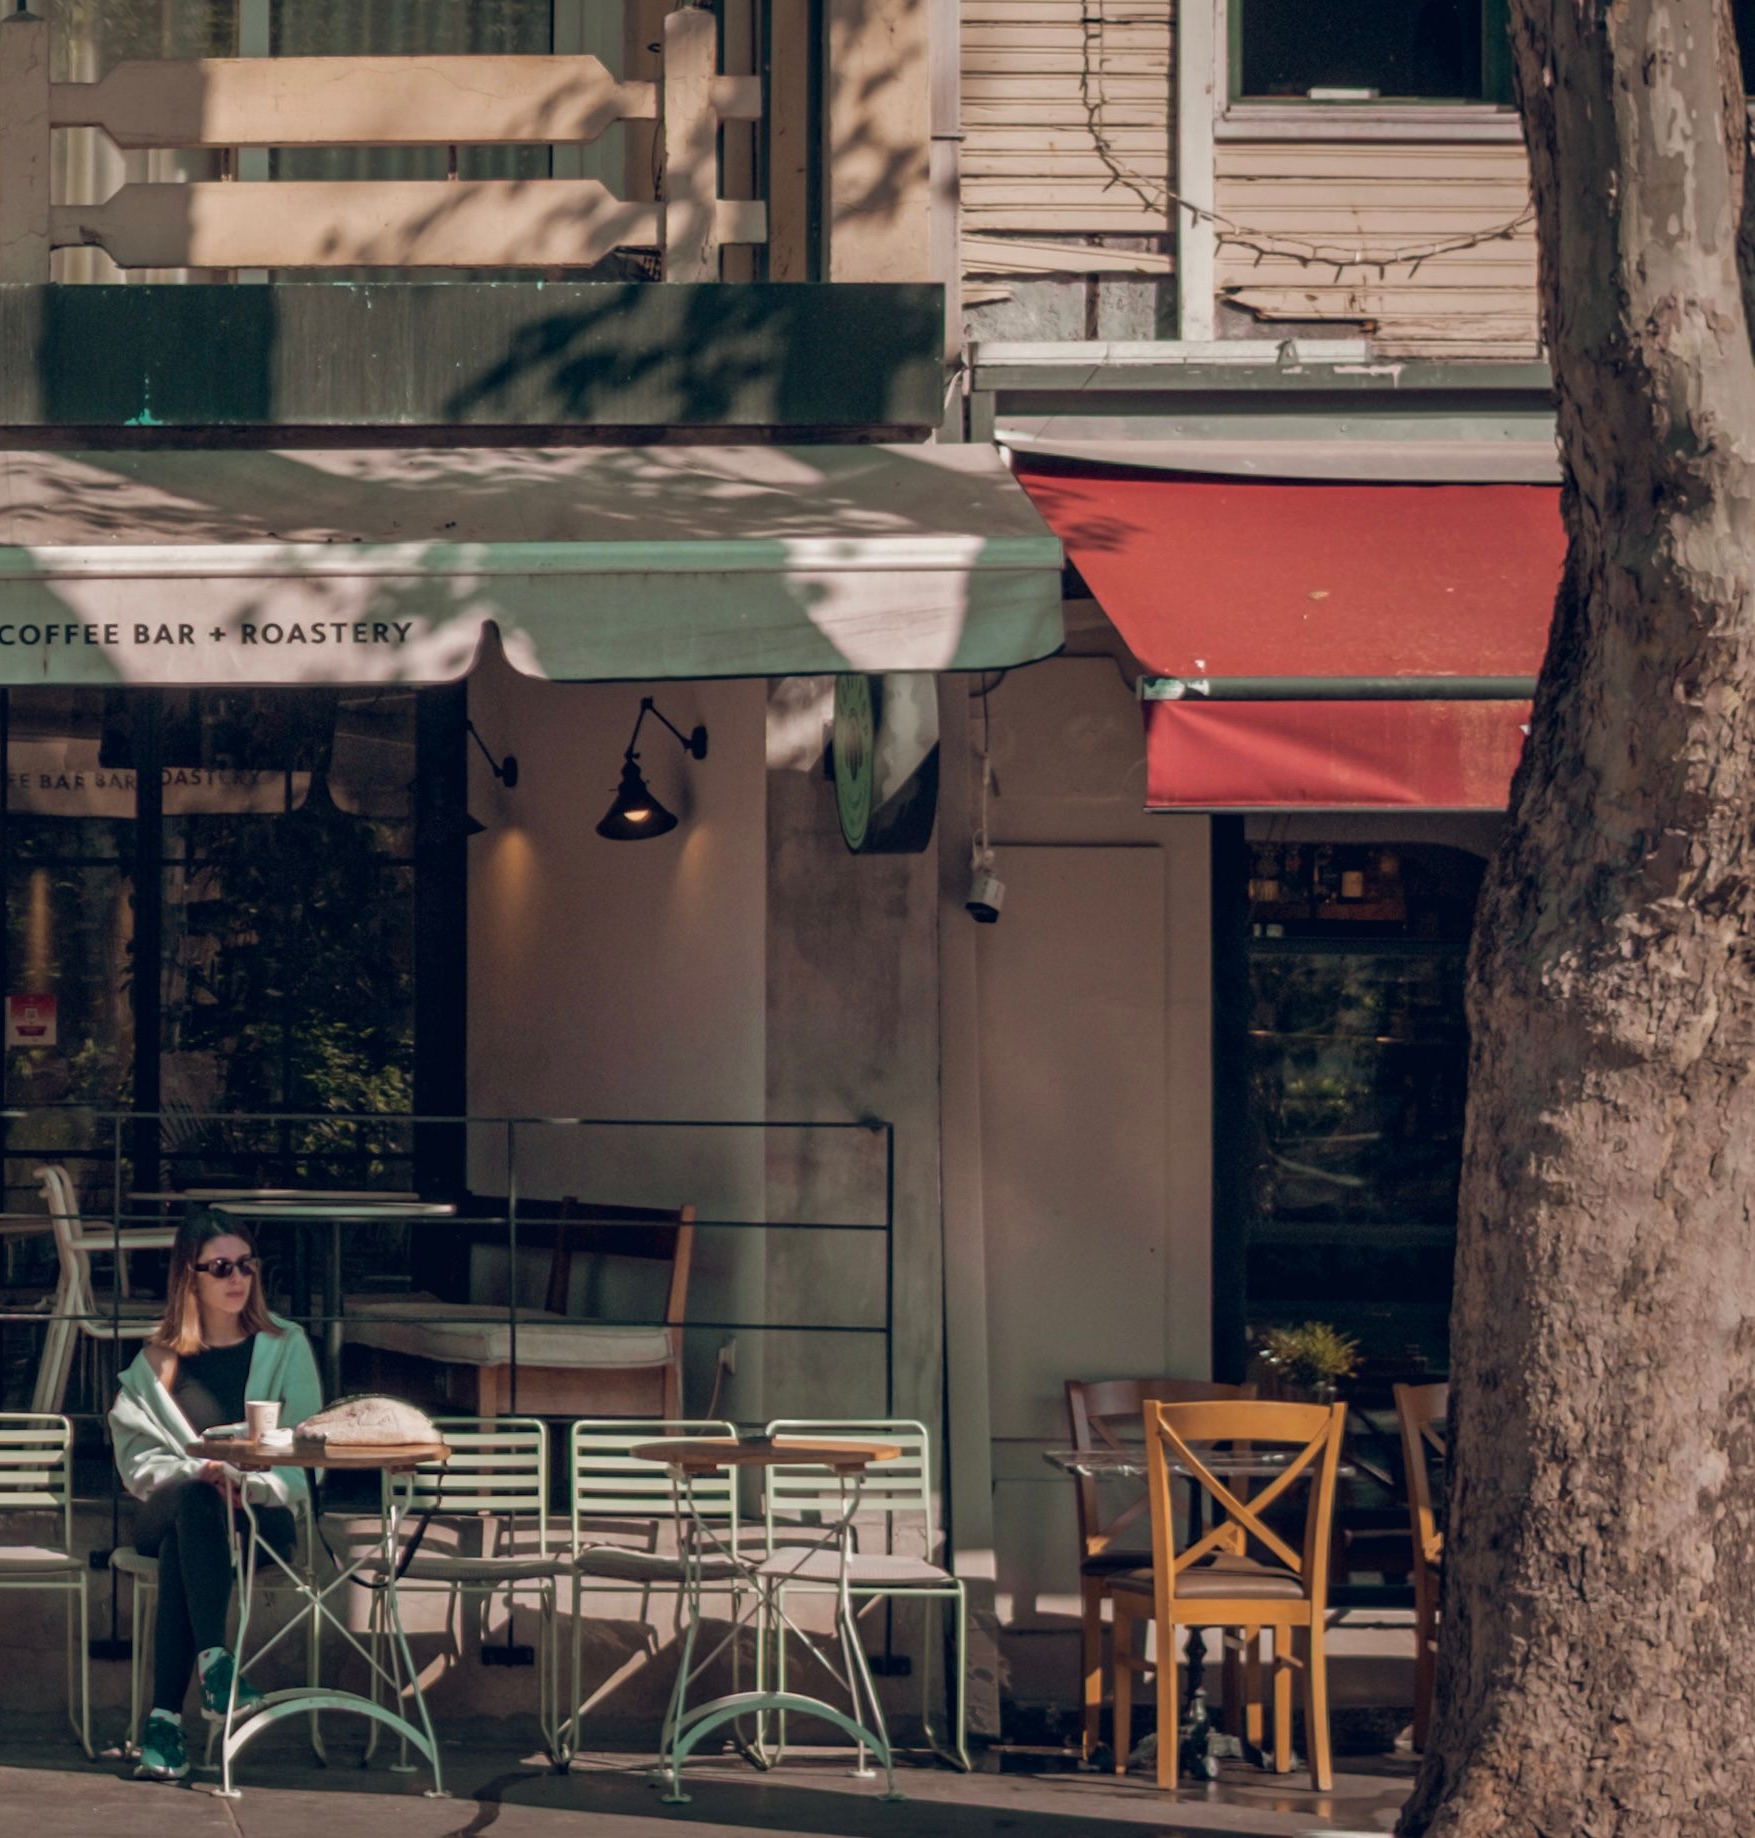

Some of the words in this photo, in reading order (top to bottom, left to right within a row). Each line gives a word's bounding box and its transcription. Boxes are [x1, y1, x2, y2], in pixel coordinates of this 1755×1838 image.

[134, 623, 195, 645] BAR
[208, 626, 227, 643] +
[242, 622, 412, 645] ROASTERY
